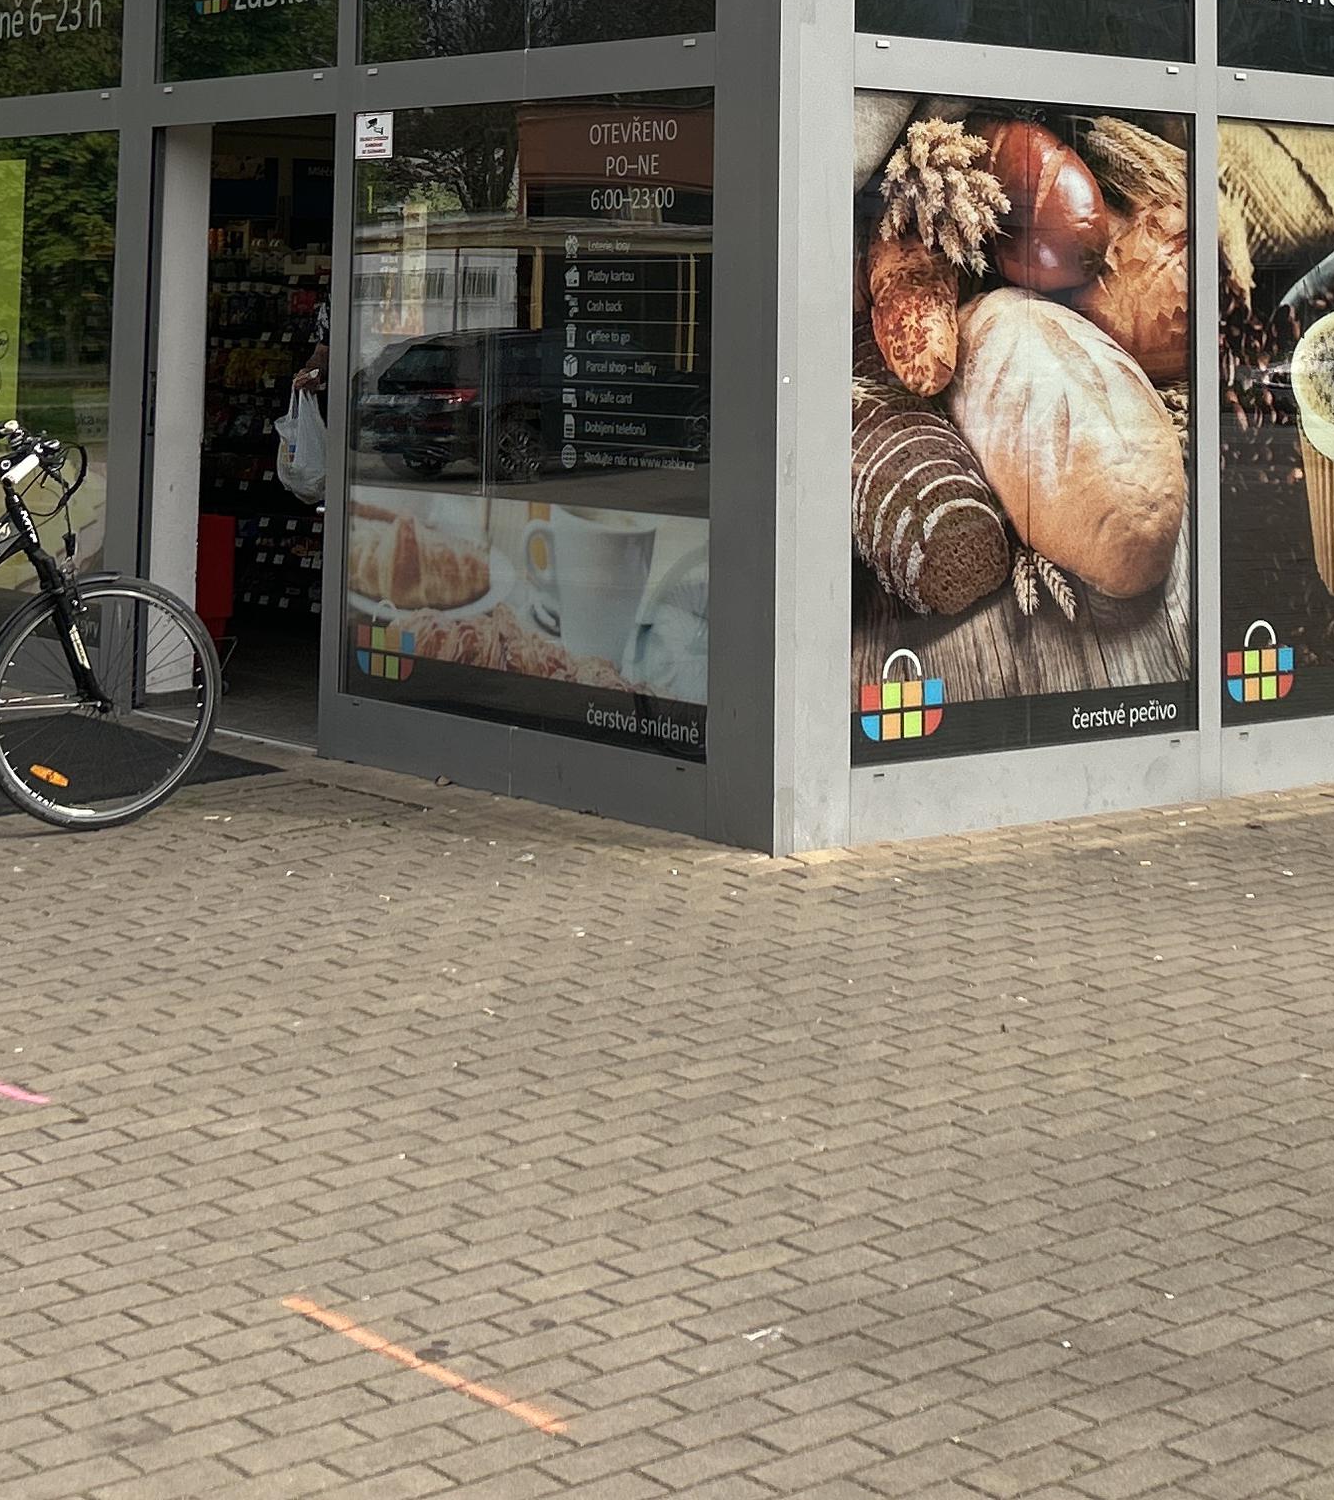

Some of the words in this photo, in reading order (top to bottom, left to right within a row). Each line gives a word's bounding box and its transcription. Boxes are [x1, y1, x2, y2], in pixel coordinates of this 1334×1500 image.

[589, 116, 679, 145] OTEVŘENO
[587, 270, 609, 284] Platby
[610, 270, 635, 283] kartou
[586, 300, 604, 312] Cash
[605, 300, 624, 313] back
[611, 331, 619, 342] to
[620, 333, 631, 346] go
[585, 360, 608, 373] Parcel
[609, 361, 627, 375] shop
[585, 390, 598, 404] Pay
[599, 391, 615, 403] safe
[616, 392, 633, 404] card
[1072, 702, 1126, 729] čerstvé
[1129, 700, 1177, 728] pečivo
[587, 702, 637, 734] čerstvá
[640, 714, 699, 744] snídaně
